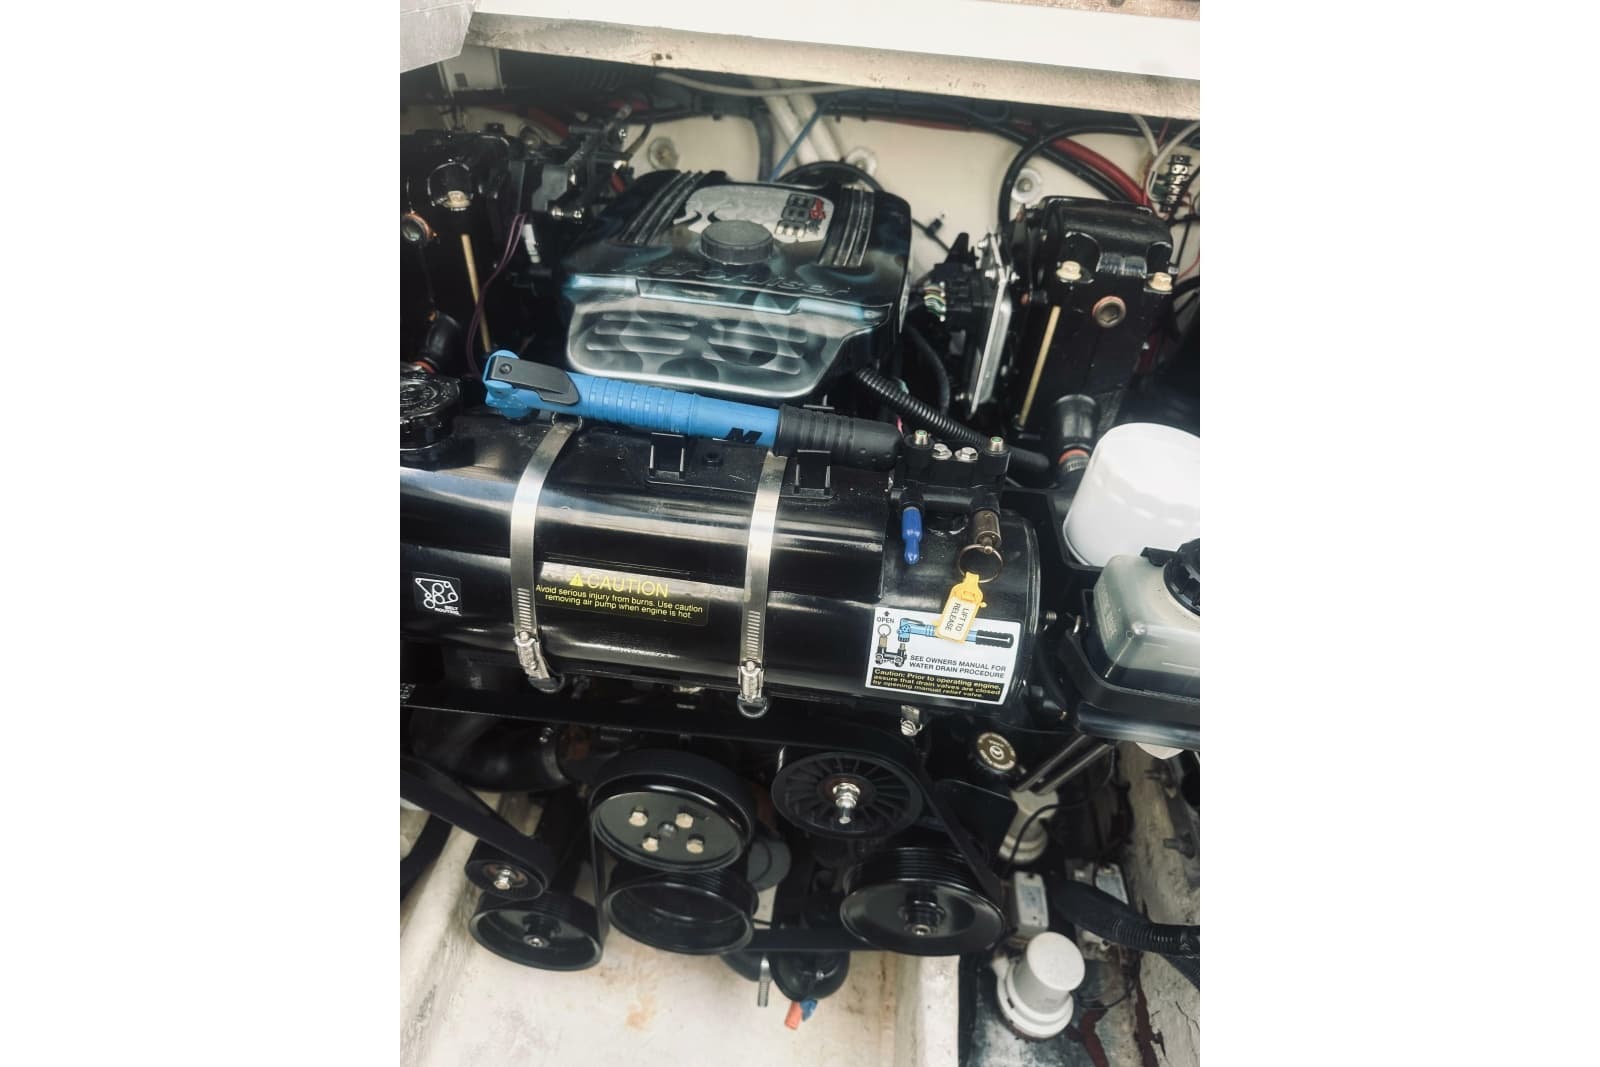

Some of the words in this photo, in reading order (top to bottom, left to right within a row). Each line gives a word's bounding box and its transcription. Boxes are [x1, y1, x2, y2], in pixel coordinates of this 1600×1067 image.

[587, 573, 669, 598] CAUTION
[535, 584, 557, 594] Avoid
[558, 588, 587, 598] serious
[588, 592, 610, 602] injury
[612, 595, 630, 603] from
[631, 597, 654, 607] burns.
[657, 601, 673, 609] Use
[674, 604, 703, 613] caution
[545, 594, 581, 606] removing
[594, 601, 617, 610] pump
[618, 604, 640, 612] when
[641, 606, 668, 616] engine
[945, 602, 960, 632] RELEASE
[909, 661, 934, 670] WATER
[935, 665, 958, 673] DRAIN
[959, 667, 1005, 679] PROCEDURE
[910, 654, 924, 662] SEE
[925, 656, 957, 666] OWNERS
[958, 661, 990, 670] MANUAL
[991, 664, 1007, 672] FOR
[874, 669, 905, 678] Caution:
[907, 672, 926, 680] Prior
[936, 677, 973, 688] operating
[883, 681, 913, 690] opening
[914, 685, 942, 693] manual
[936, 682, 960, 690] valves
[975, 687, 1001, 695] closed
